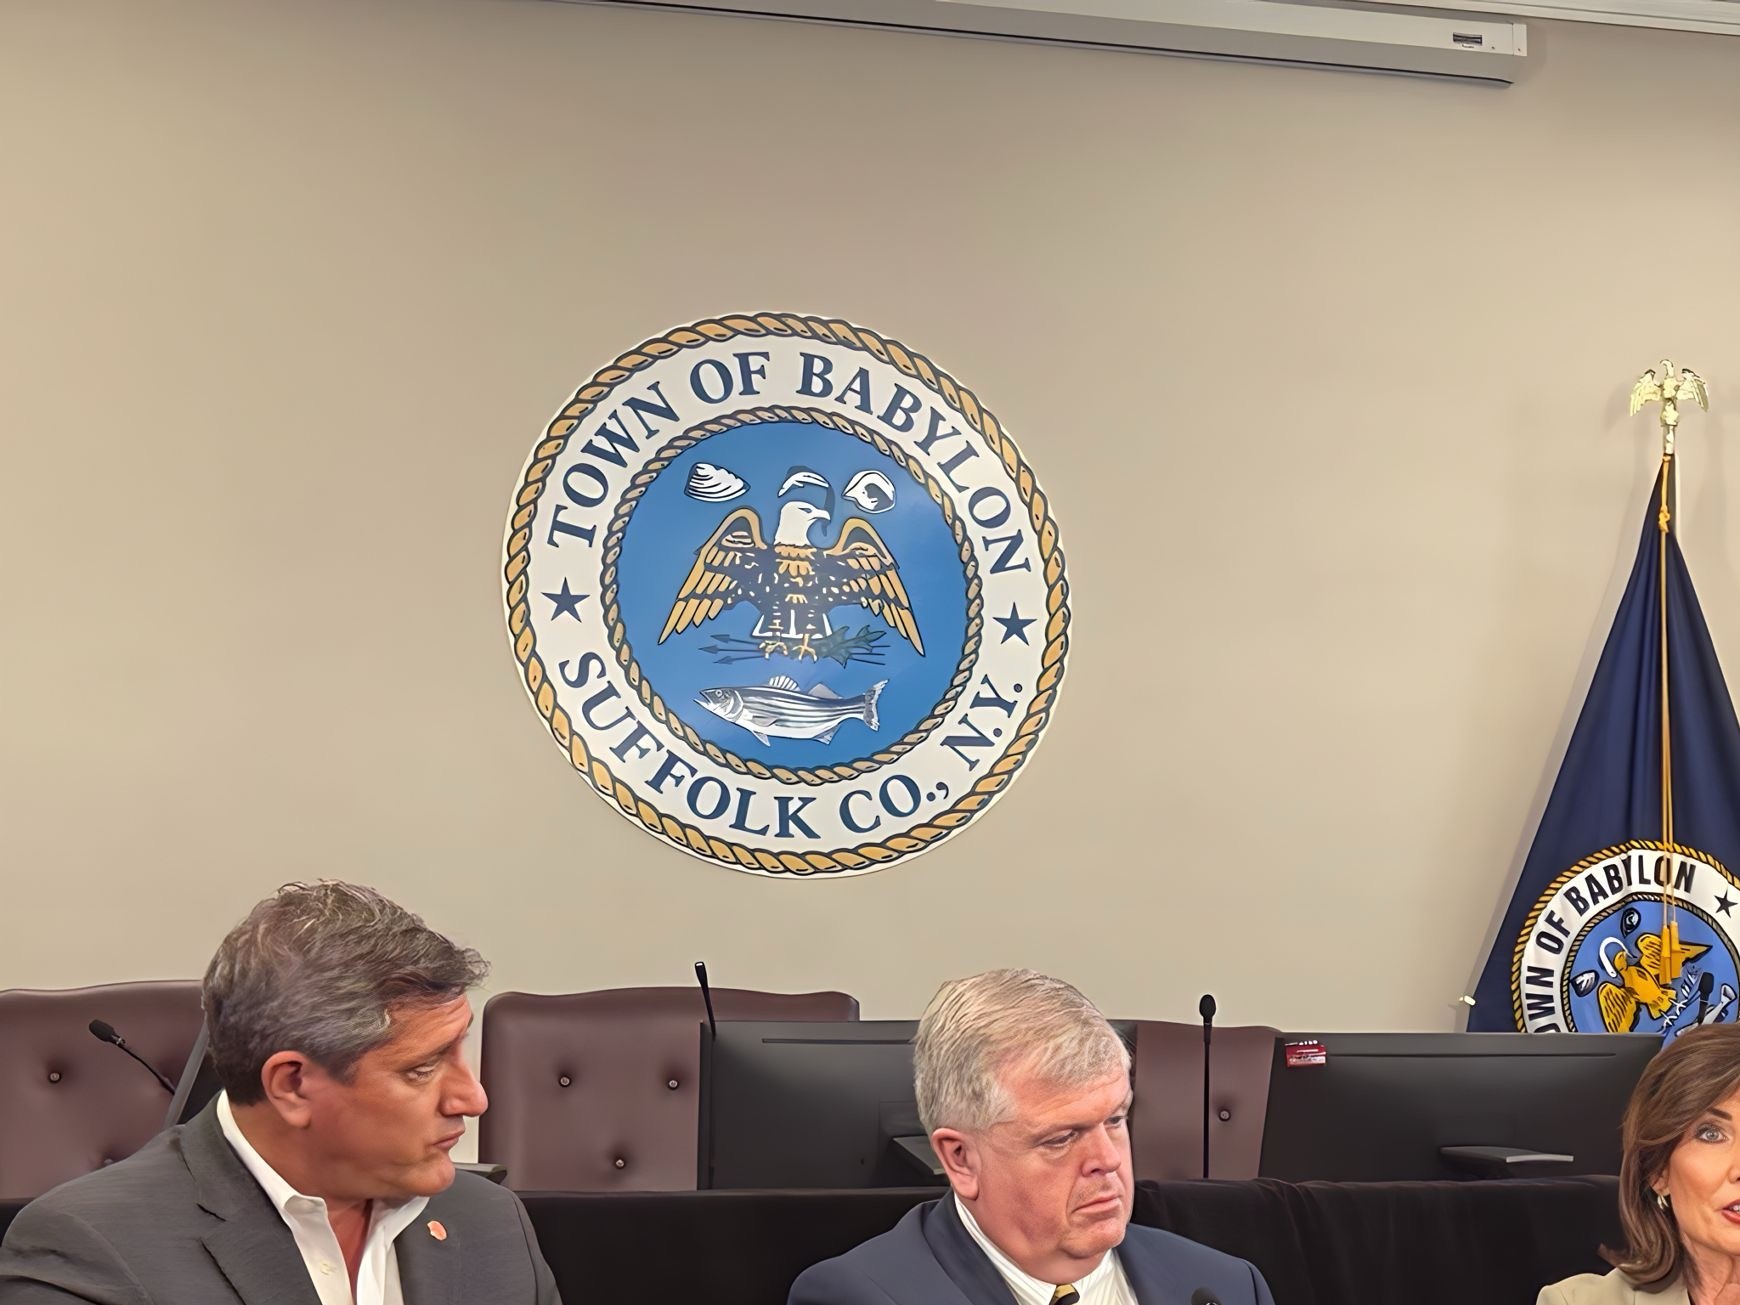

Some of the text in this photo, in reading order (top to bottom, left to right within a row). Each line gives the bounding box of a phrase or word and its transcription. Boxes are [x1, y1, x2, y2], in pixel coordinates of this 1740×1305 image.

[547, 351, 1031, 575] TOWN OF BABYLON
[558, 652, 1022, 839] SUFFOLK CO., N.Y.
[1535, 909, 1571, 955] OF
[1563, 854, 1697, 917] BABYLON
